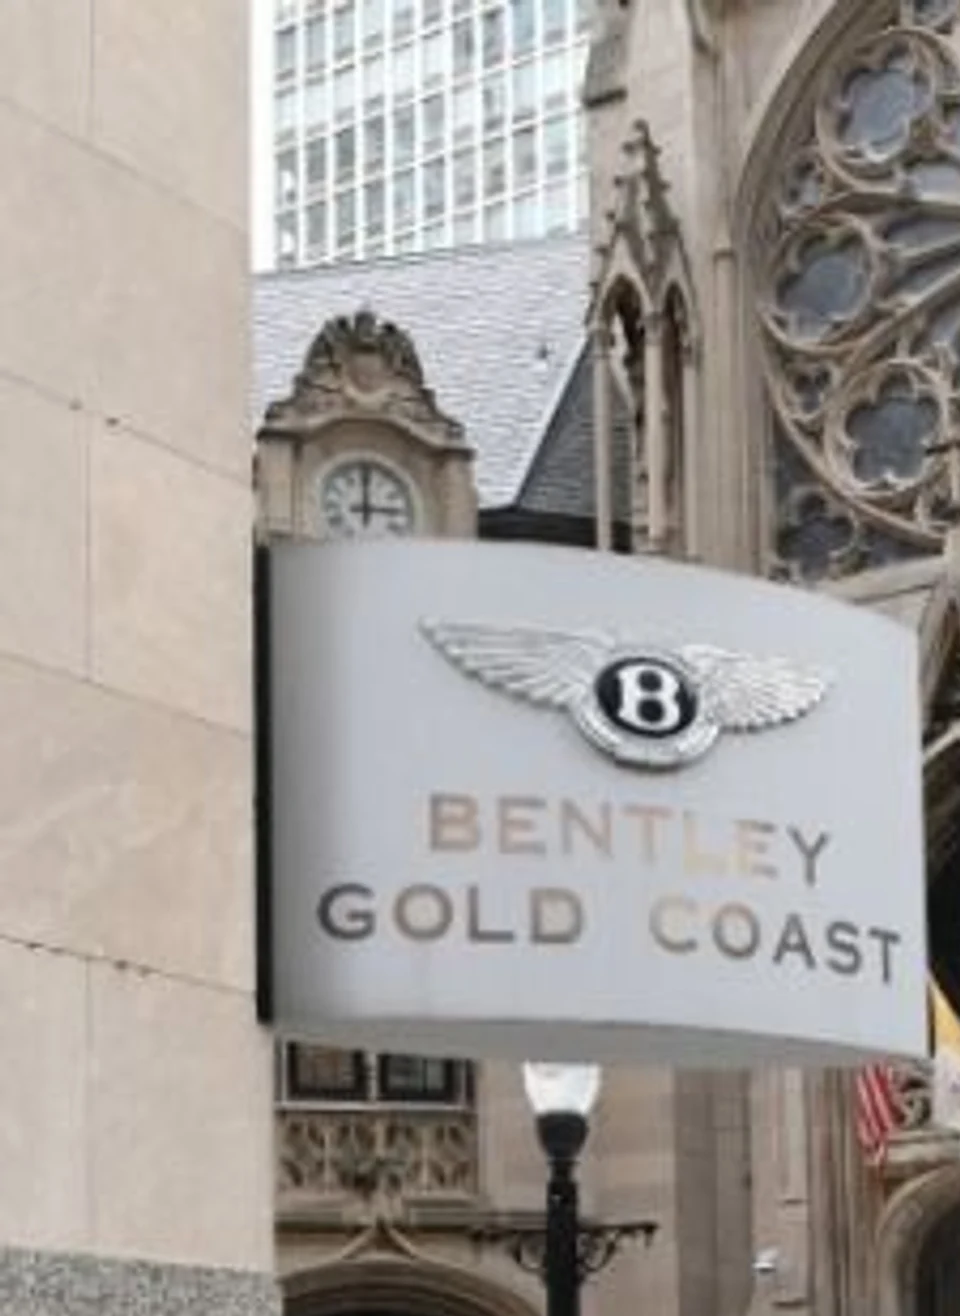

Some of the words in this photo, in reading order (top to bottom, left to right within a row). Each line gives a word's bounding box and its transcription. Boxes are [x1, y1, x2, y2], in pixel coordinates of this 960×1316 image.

[427, 792, 831, 886] BENTLEY
[316, 882, 584, 945] GOLD
[649, 893, 902, 984] COAST
